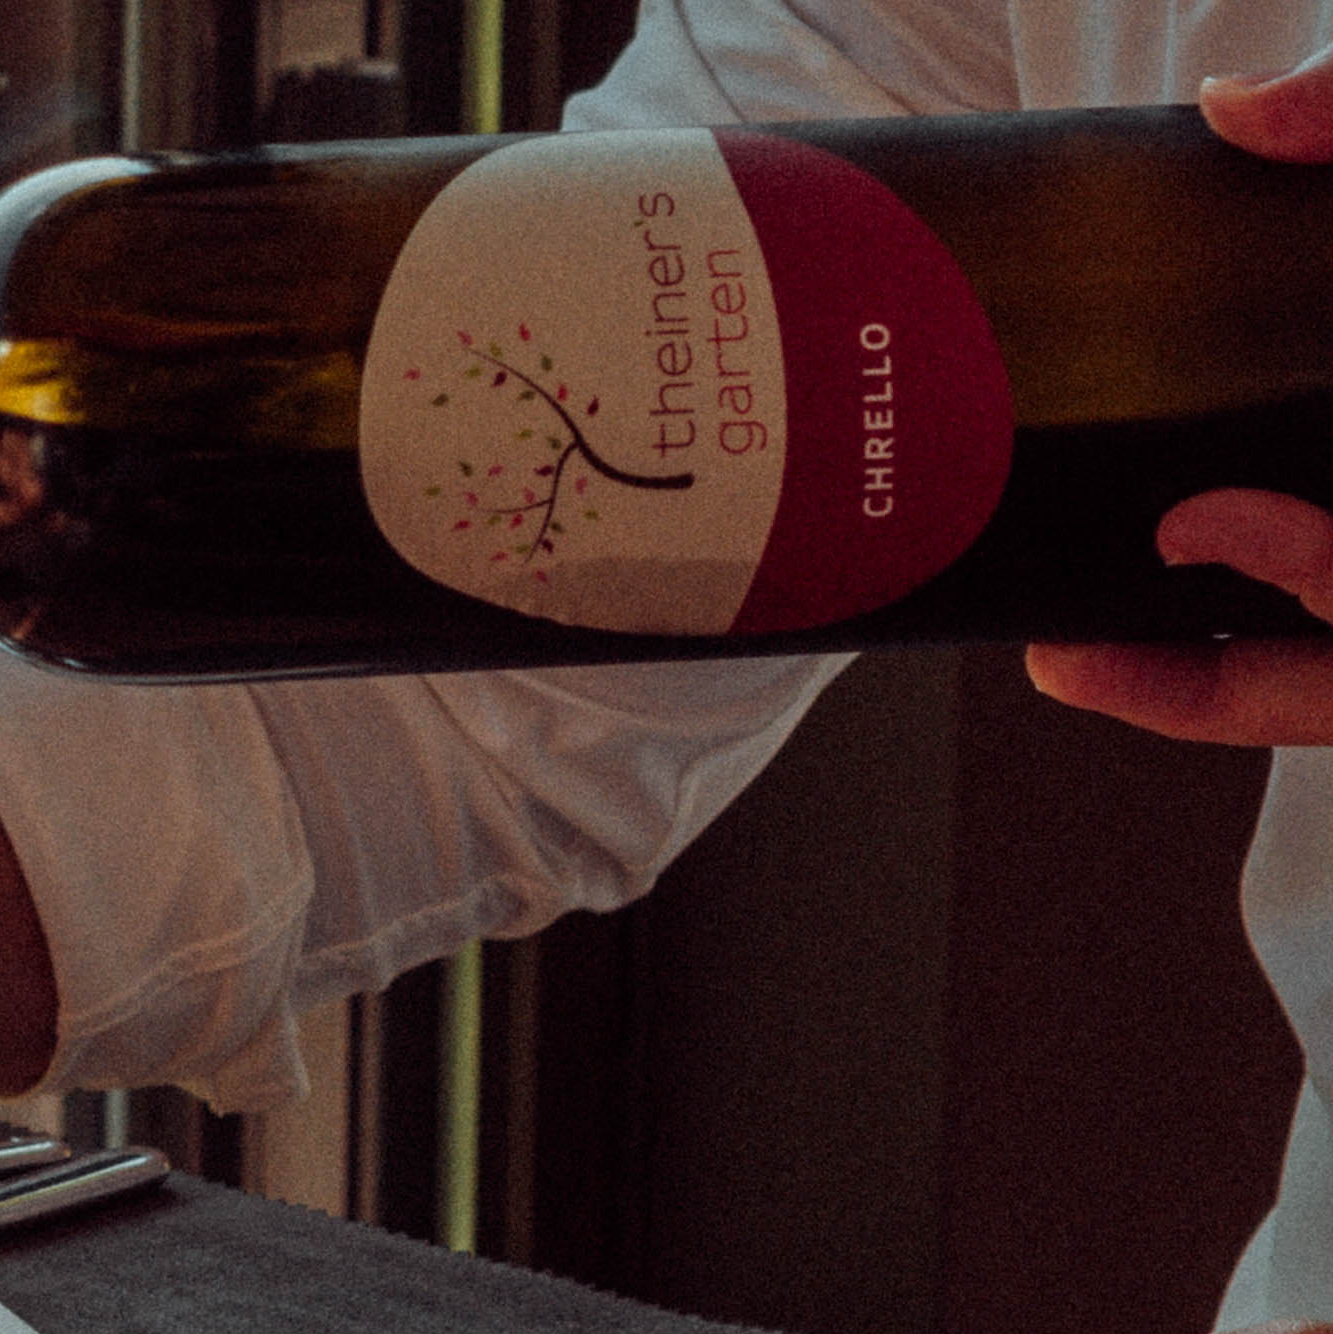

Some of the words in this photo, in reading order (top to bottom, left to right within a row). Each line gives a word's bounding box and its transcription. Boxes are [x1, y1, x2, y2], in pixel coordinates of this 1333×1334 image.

[634, 191, 695, 458] theiner's
[708, 248, 767, 456] garten
[859, 322, 895, 518] CHRELLO
